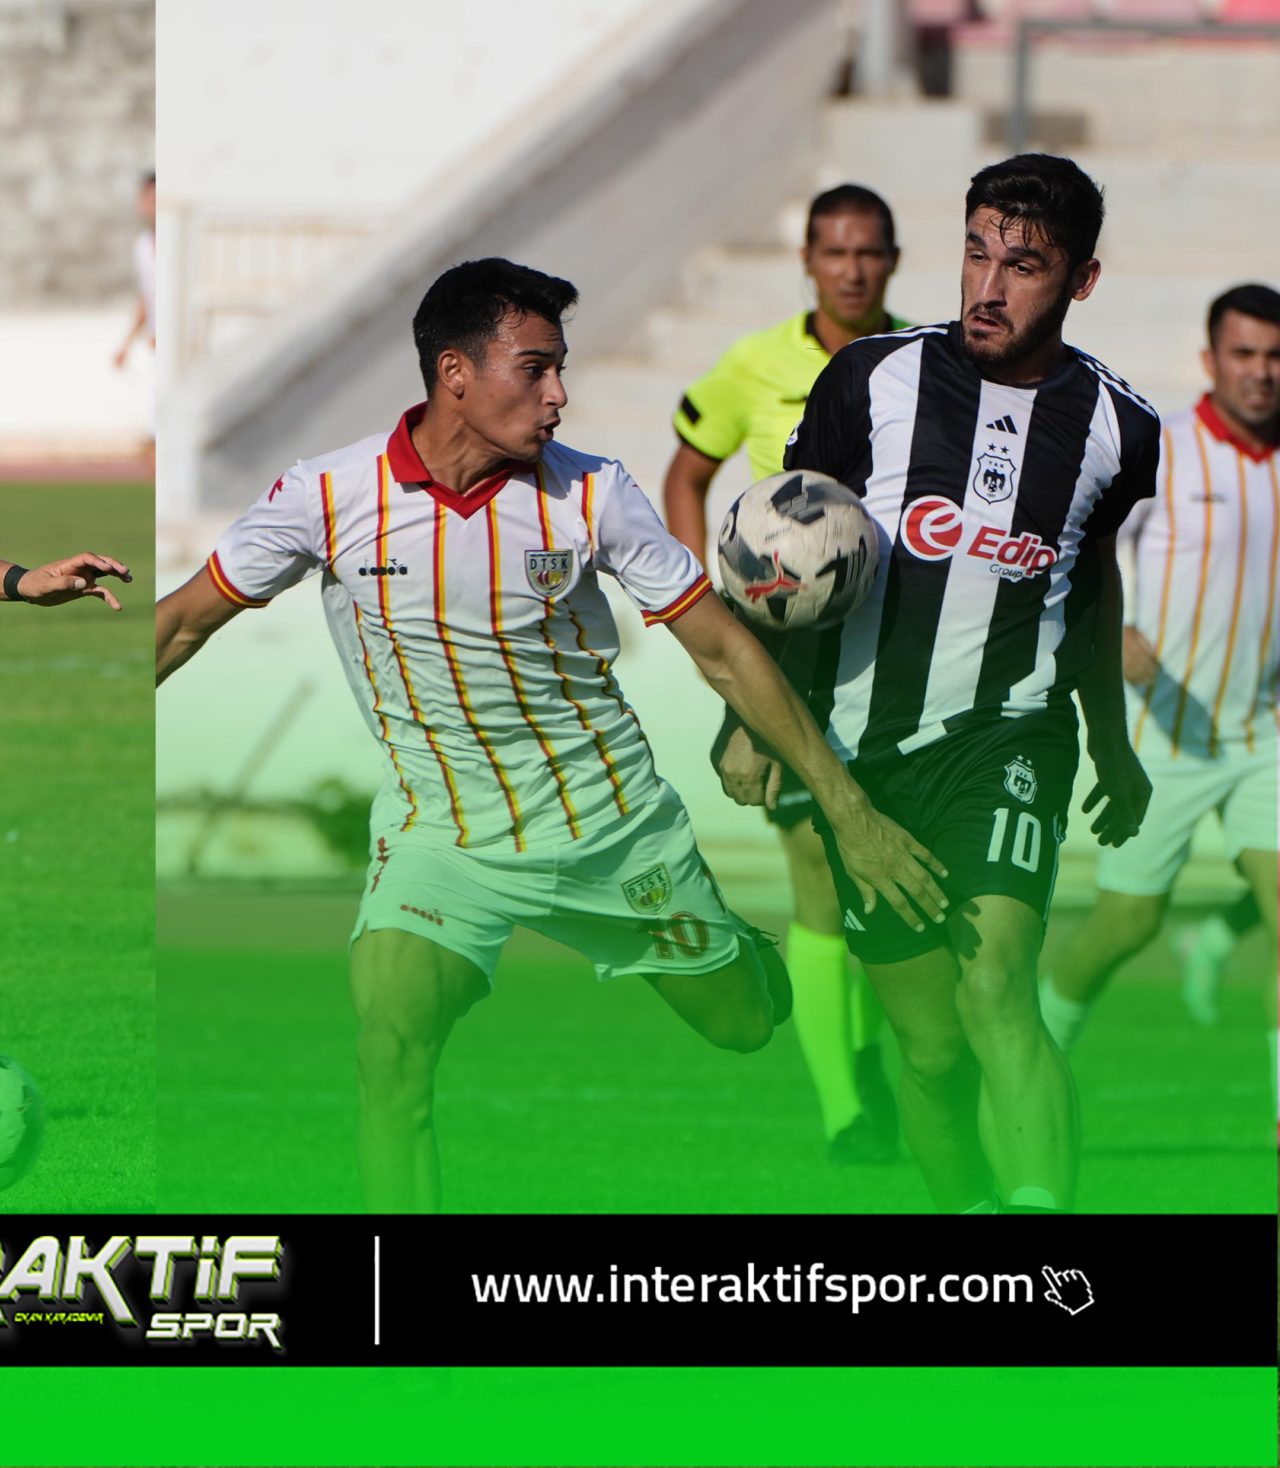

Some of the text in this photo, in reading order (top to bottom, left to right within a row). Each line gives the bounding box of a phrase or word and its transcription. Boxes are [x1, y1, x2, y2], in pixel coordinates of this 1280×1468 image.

[530, 557, 569, 570] DTSK
[967, 525, 1057, 577] Edip
[987, 807, 1042, 873] 10
[637, 911, 710, 960] 10
